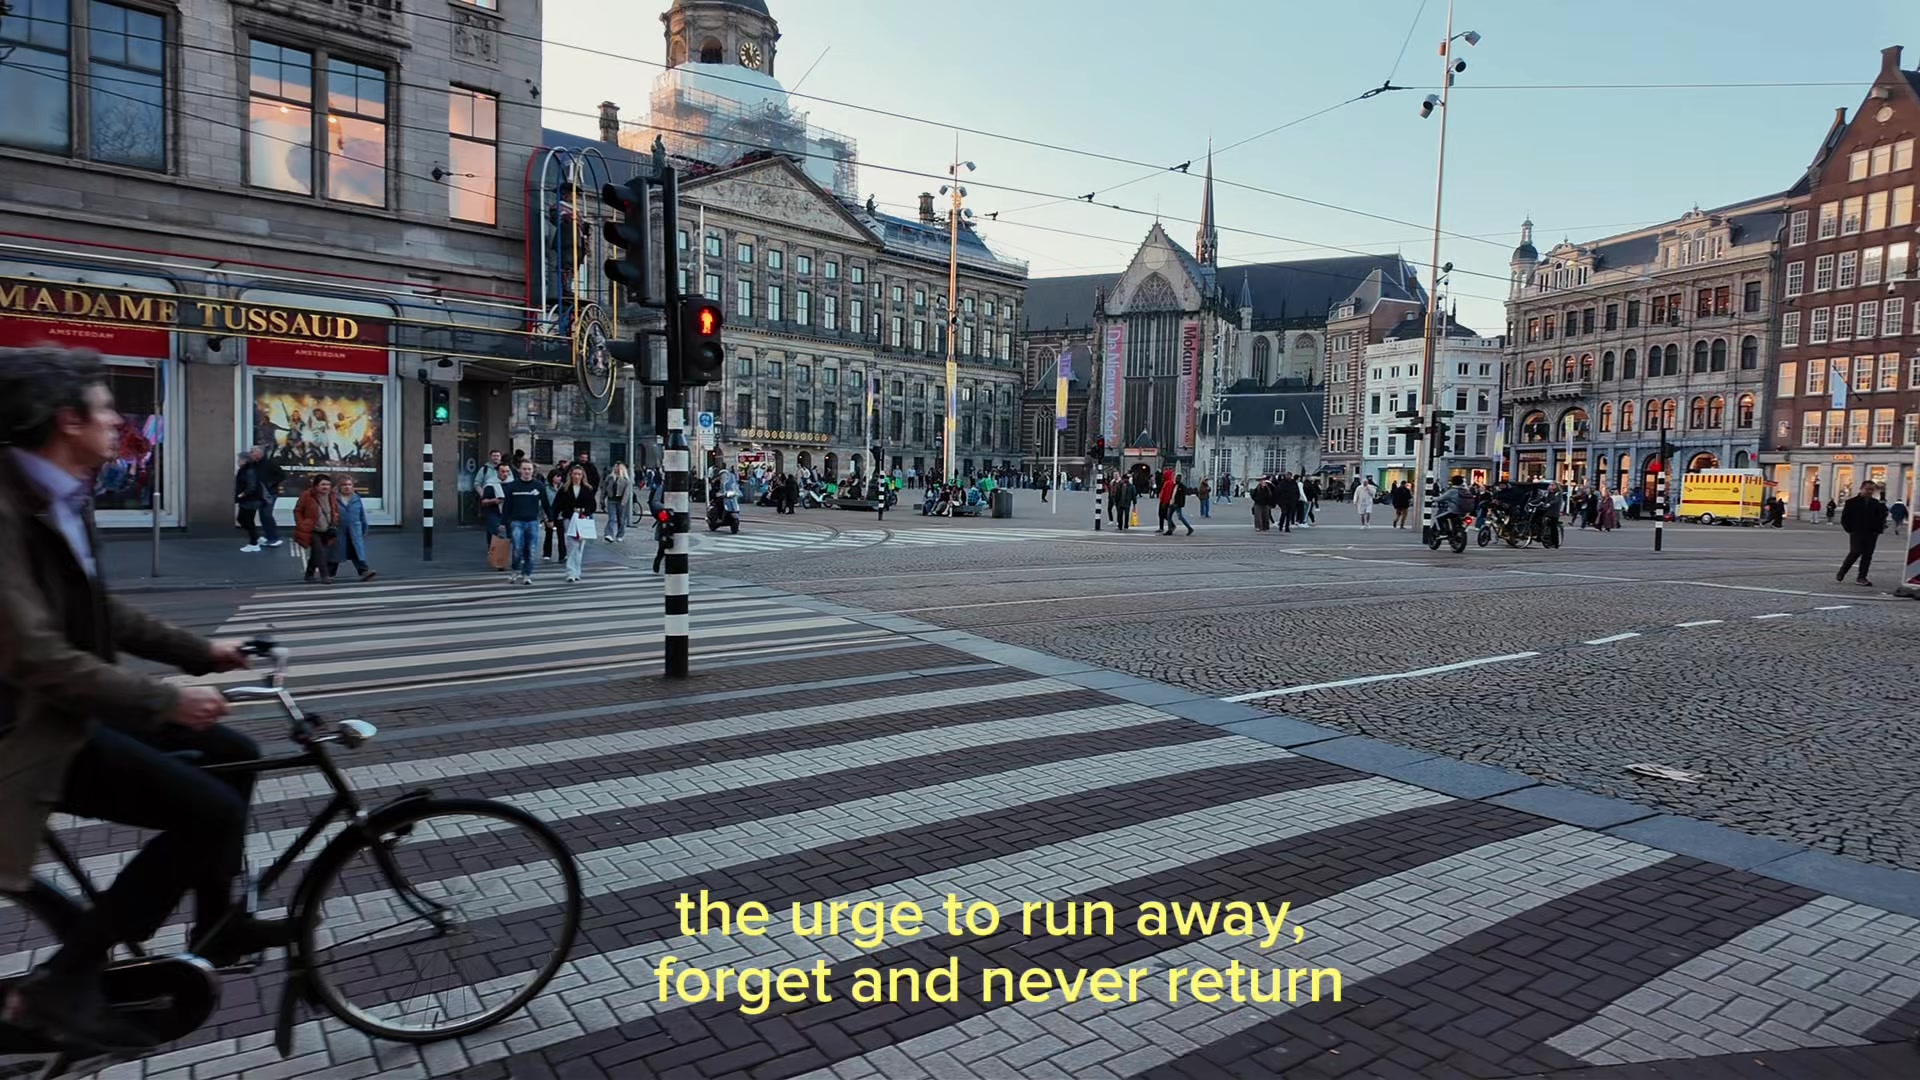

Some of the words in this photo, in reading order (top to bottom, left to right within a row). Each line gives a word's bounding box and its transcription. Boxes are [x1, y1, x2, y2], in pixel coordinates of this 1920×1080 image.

[0, 284, 179, 324] MADAME
[197, 302, 359, 340] TUSSAUD
[49, 328, 115, 339] AMSTERDAM
[1107, 329, 1121, 350] De
[295, 349, 346, 359] AMSTERDAM
[1182, 326, 1197, 376] Mokum
[1105, 352, 1120, 407] Nieuwe
[1104, 409, 1118, 443] Kerk
